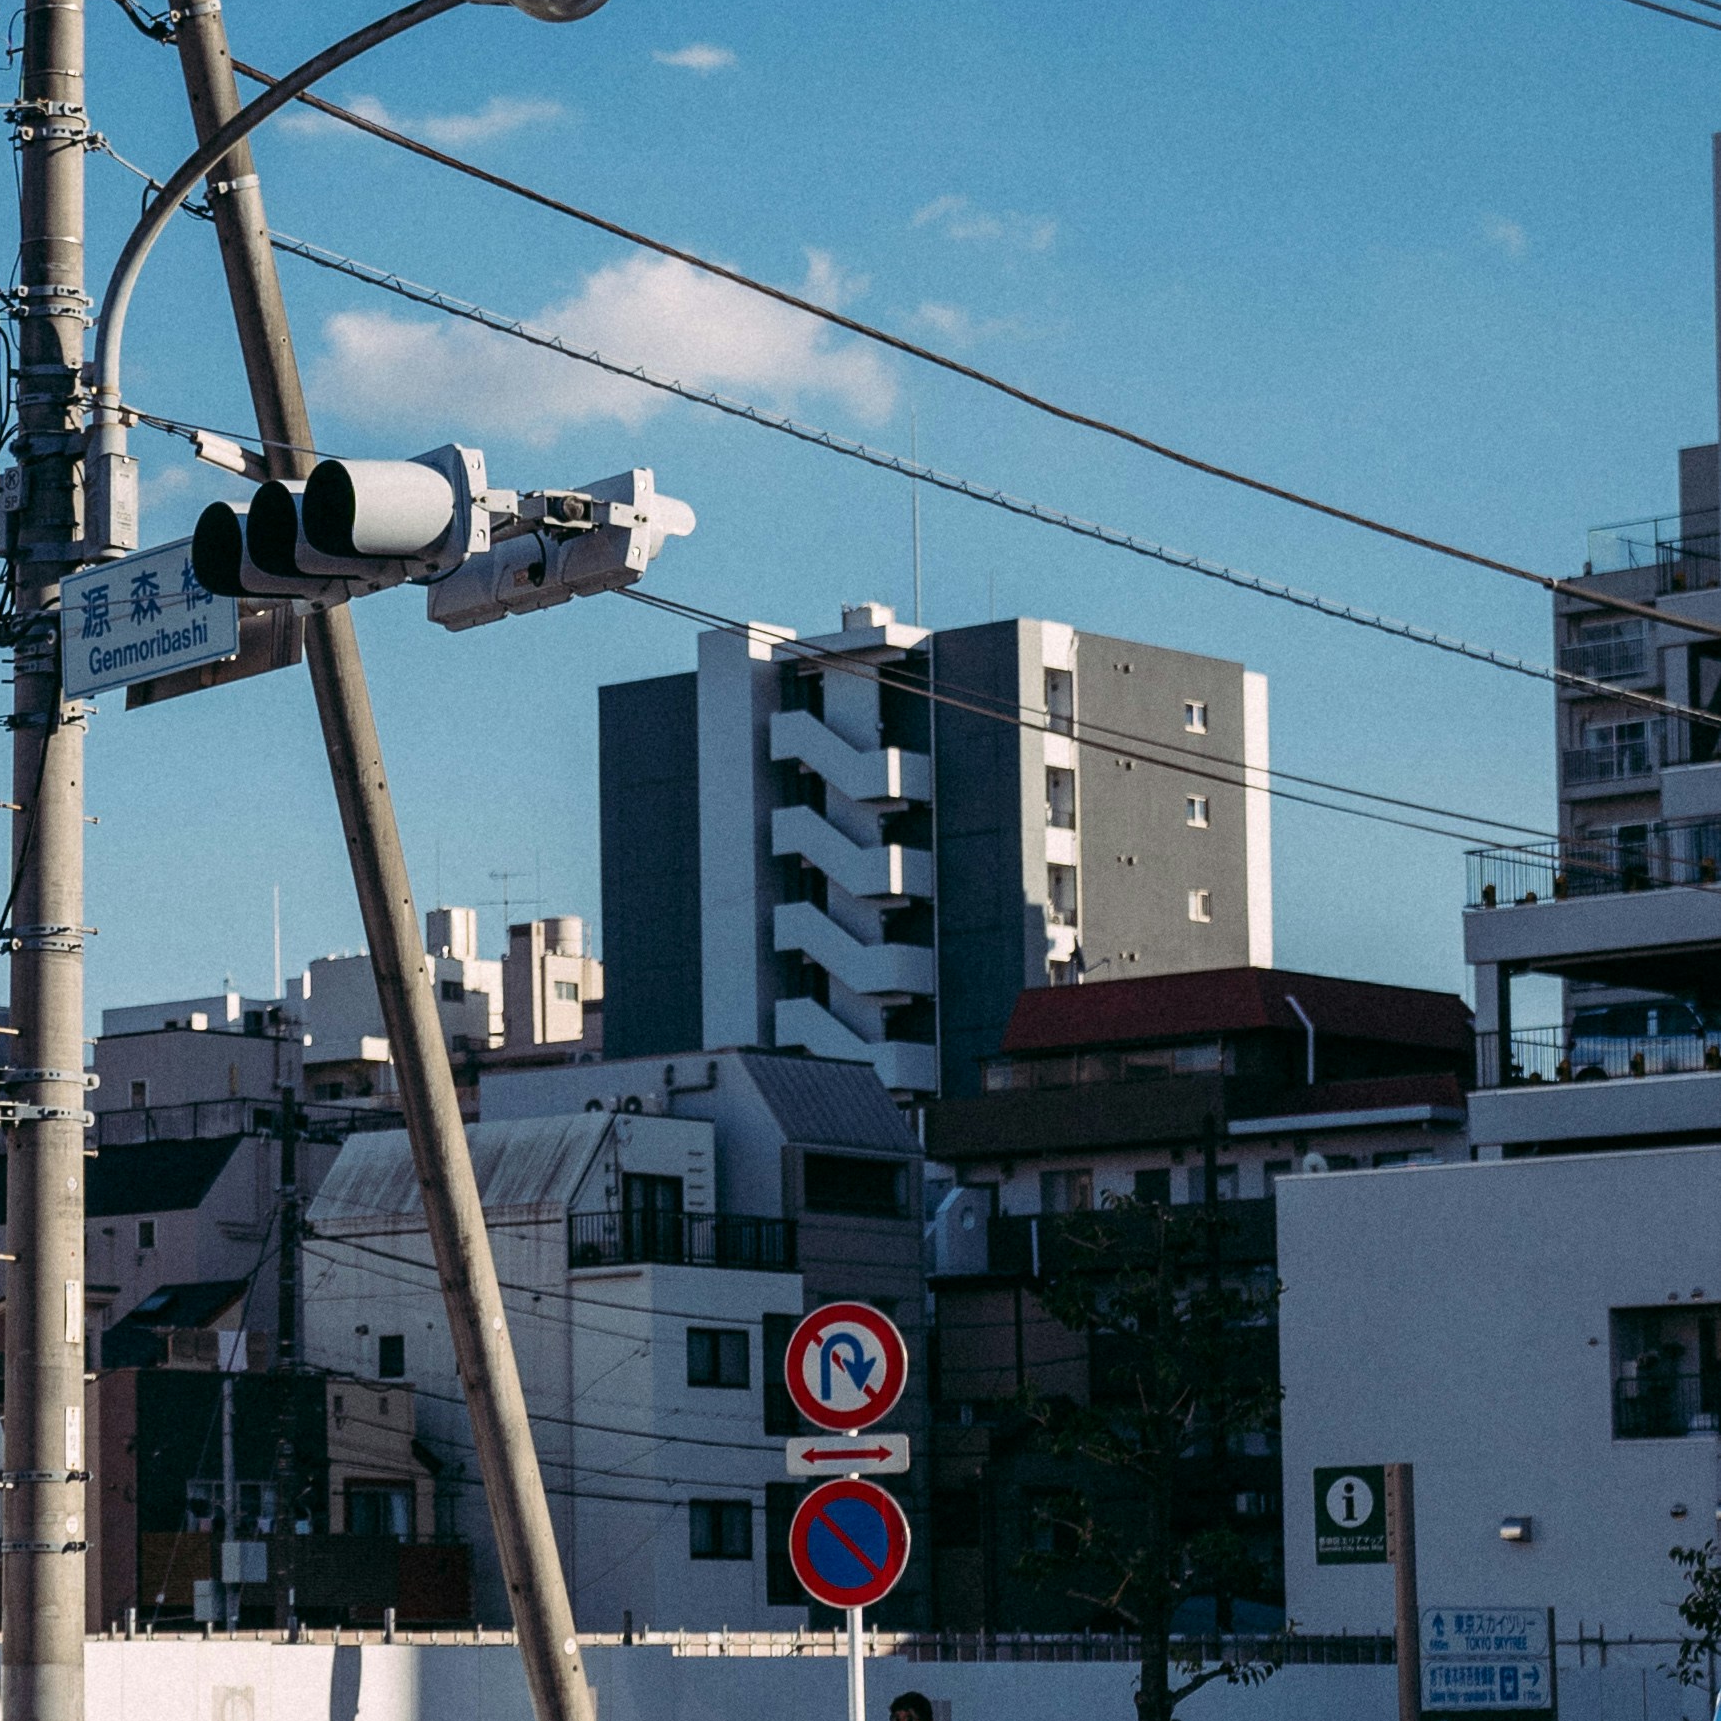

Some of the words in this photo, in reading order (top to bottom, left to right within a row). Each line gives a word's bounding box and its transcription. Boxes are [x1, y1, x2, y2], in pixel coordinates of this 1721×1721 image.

[89, 615, 208, 676] Genmoribashi
[1454, 1614, 1536, 1634] 東京スカイツリー
[1465, 1636, 1491, 1650] TOKYO
